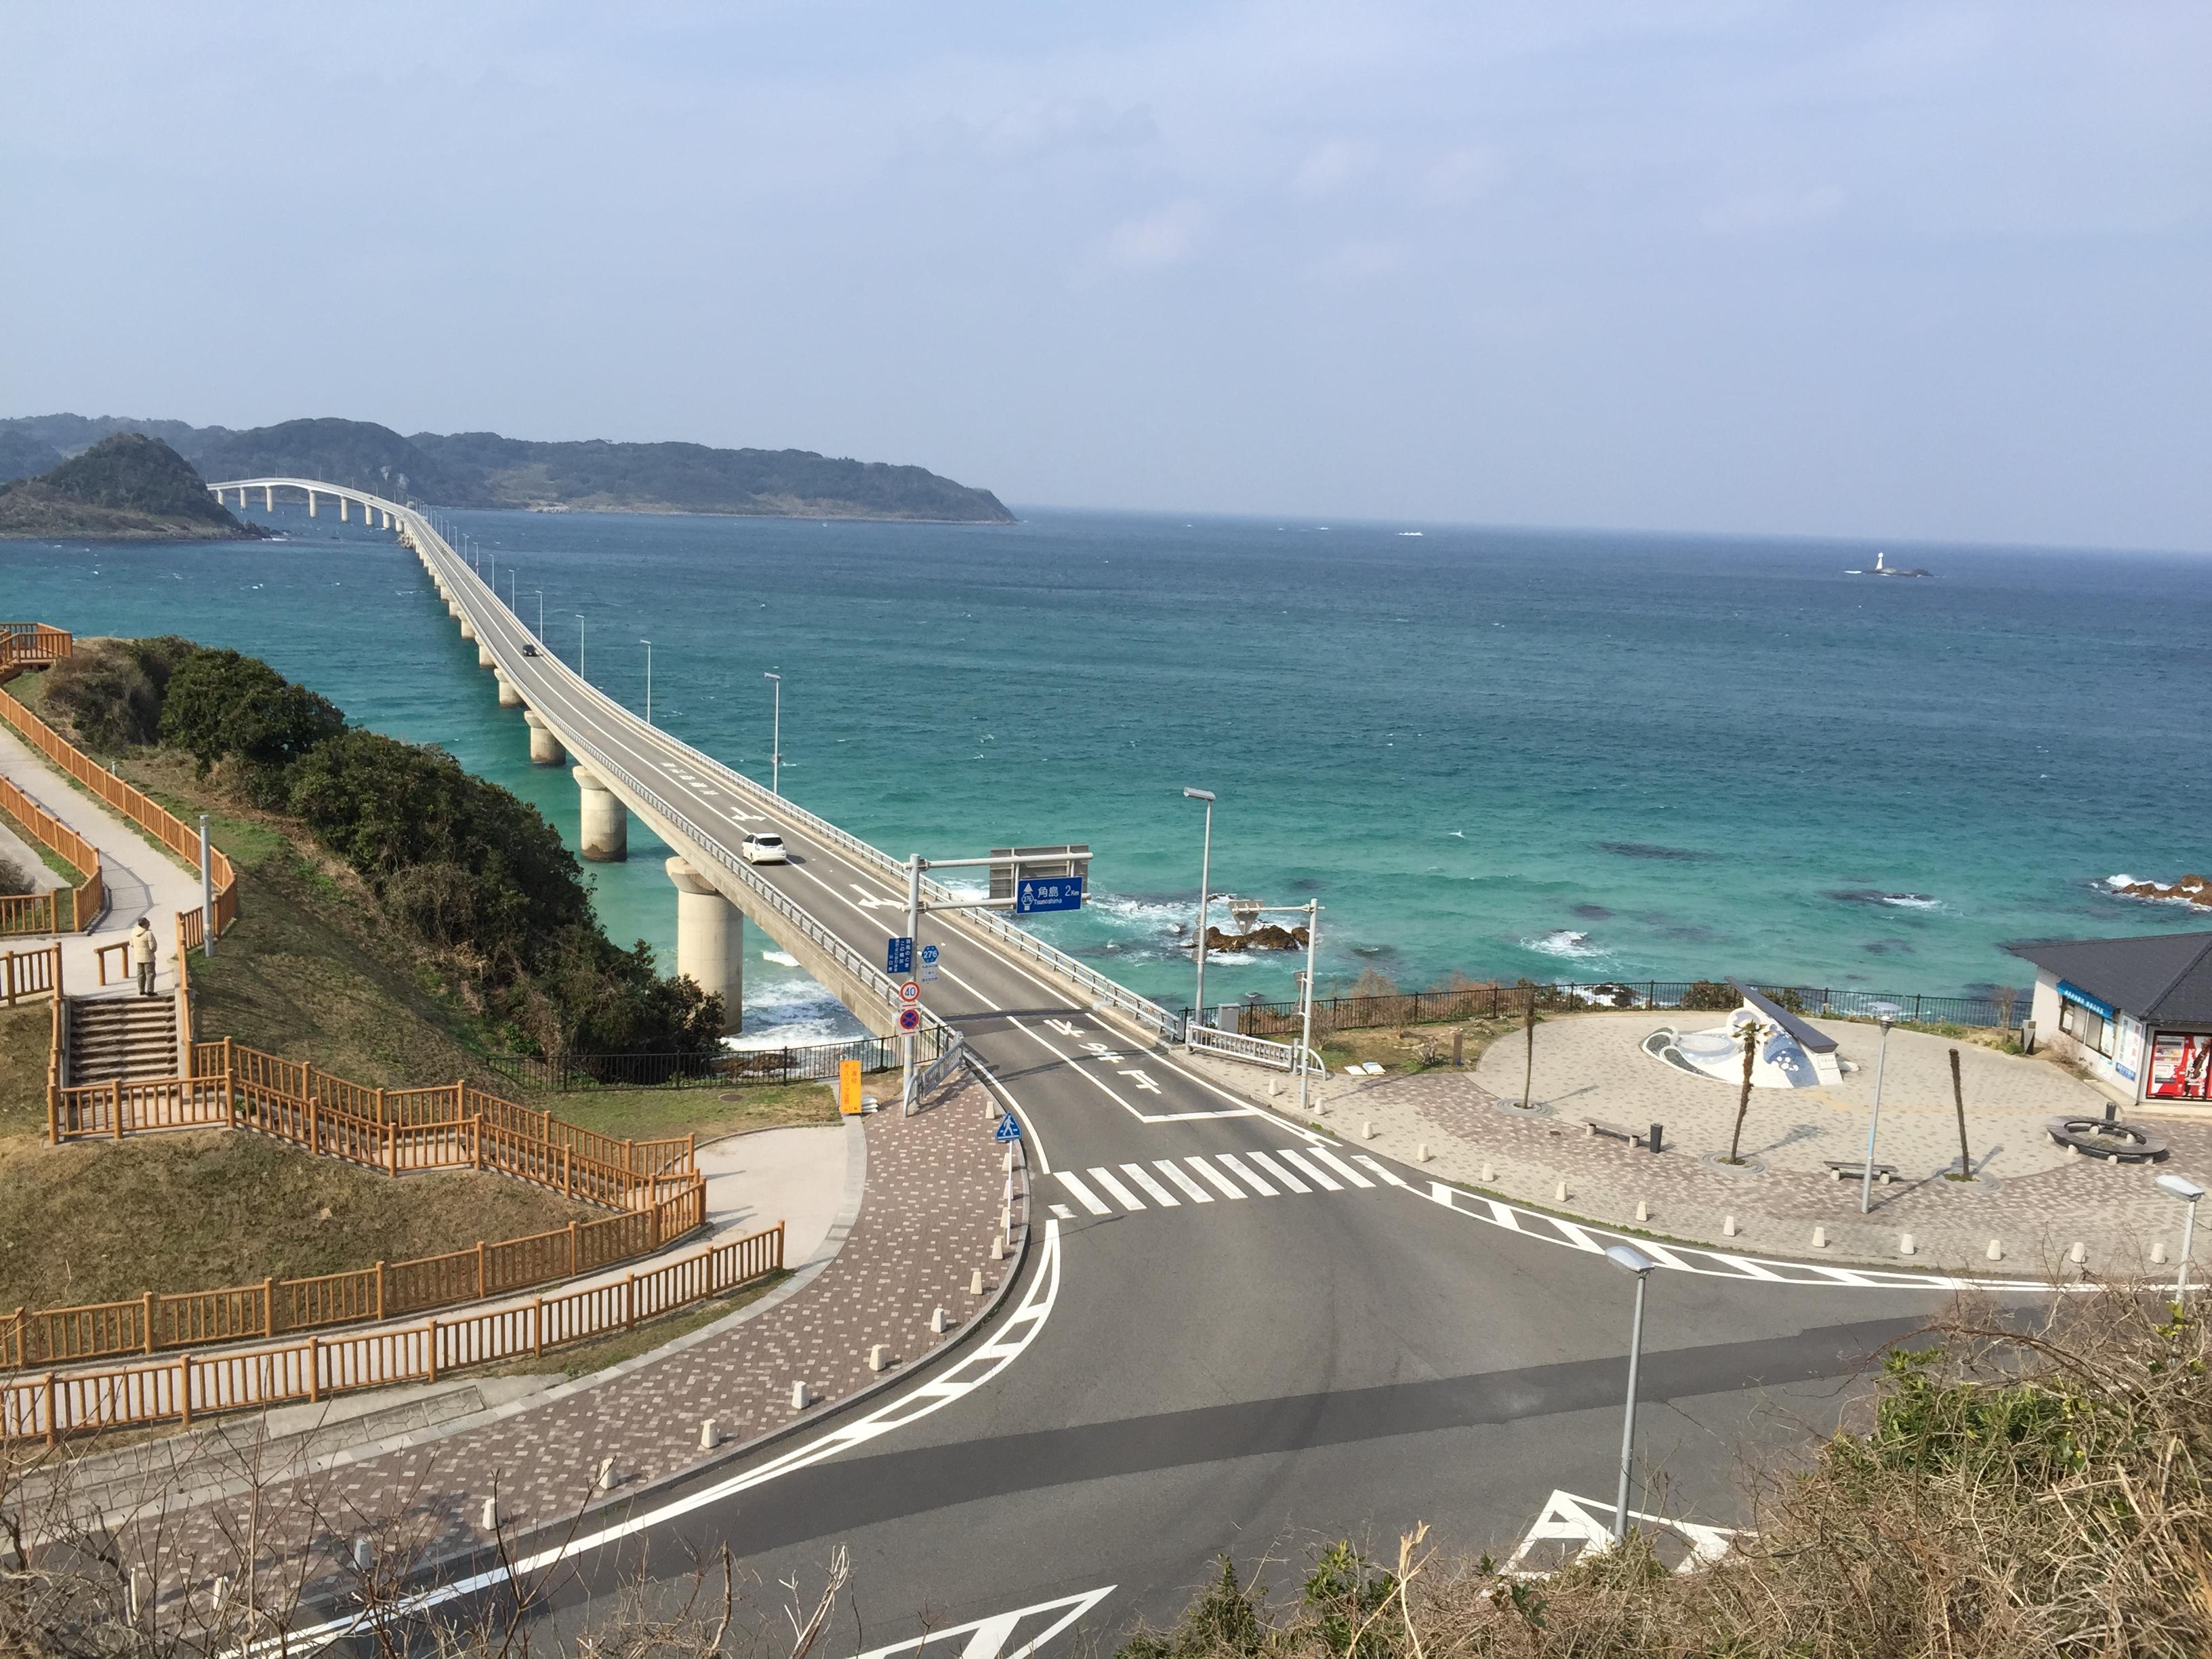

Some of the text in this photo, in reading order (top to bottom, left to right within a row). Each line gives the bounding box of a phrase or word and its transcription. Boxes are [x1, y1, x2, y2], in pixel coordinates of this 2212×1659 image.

[1038, 886, 1059, 898] 角島
[923, 950, 937, 958] 276
[905, 987, 916, 996] 40
[1043, 1019, 1162, 1094] 止まれ
